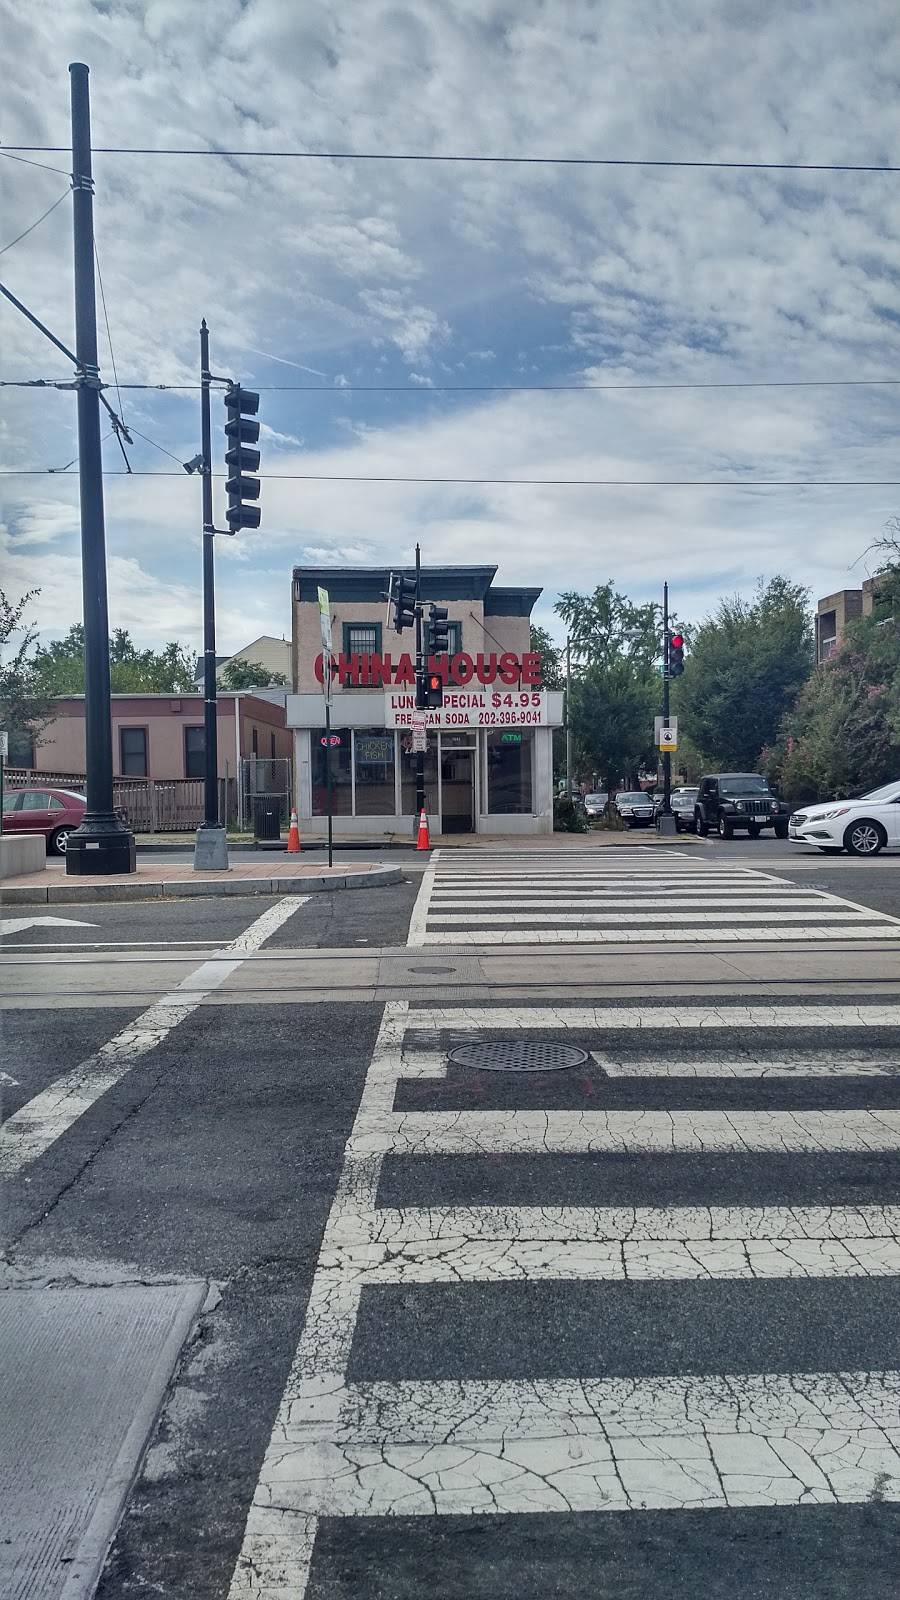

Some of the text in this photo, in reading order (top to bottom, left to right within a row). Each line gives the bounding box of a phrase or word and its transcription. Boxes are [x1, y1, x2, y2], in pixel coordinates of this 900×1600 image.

[314, 652, 542, 685] CHINA HOUSE
[391, 692, 541, 709] LUN PECIAL $4.95
[395, 713, 412, 725] FRE
[445, 713, 470, 725] SODA
[478, 711, 541, 725] 202-396-9041
[320, 737, 341, 745] OEN
[501, 734, 522, 742] ATM
[365, 751, 384, 760] FISH
